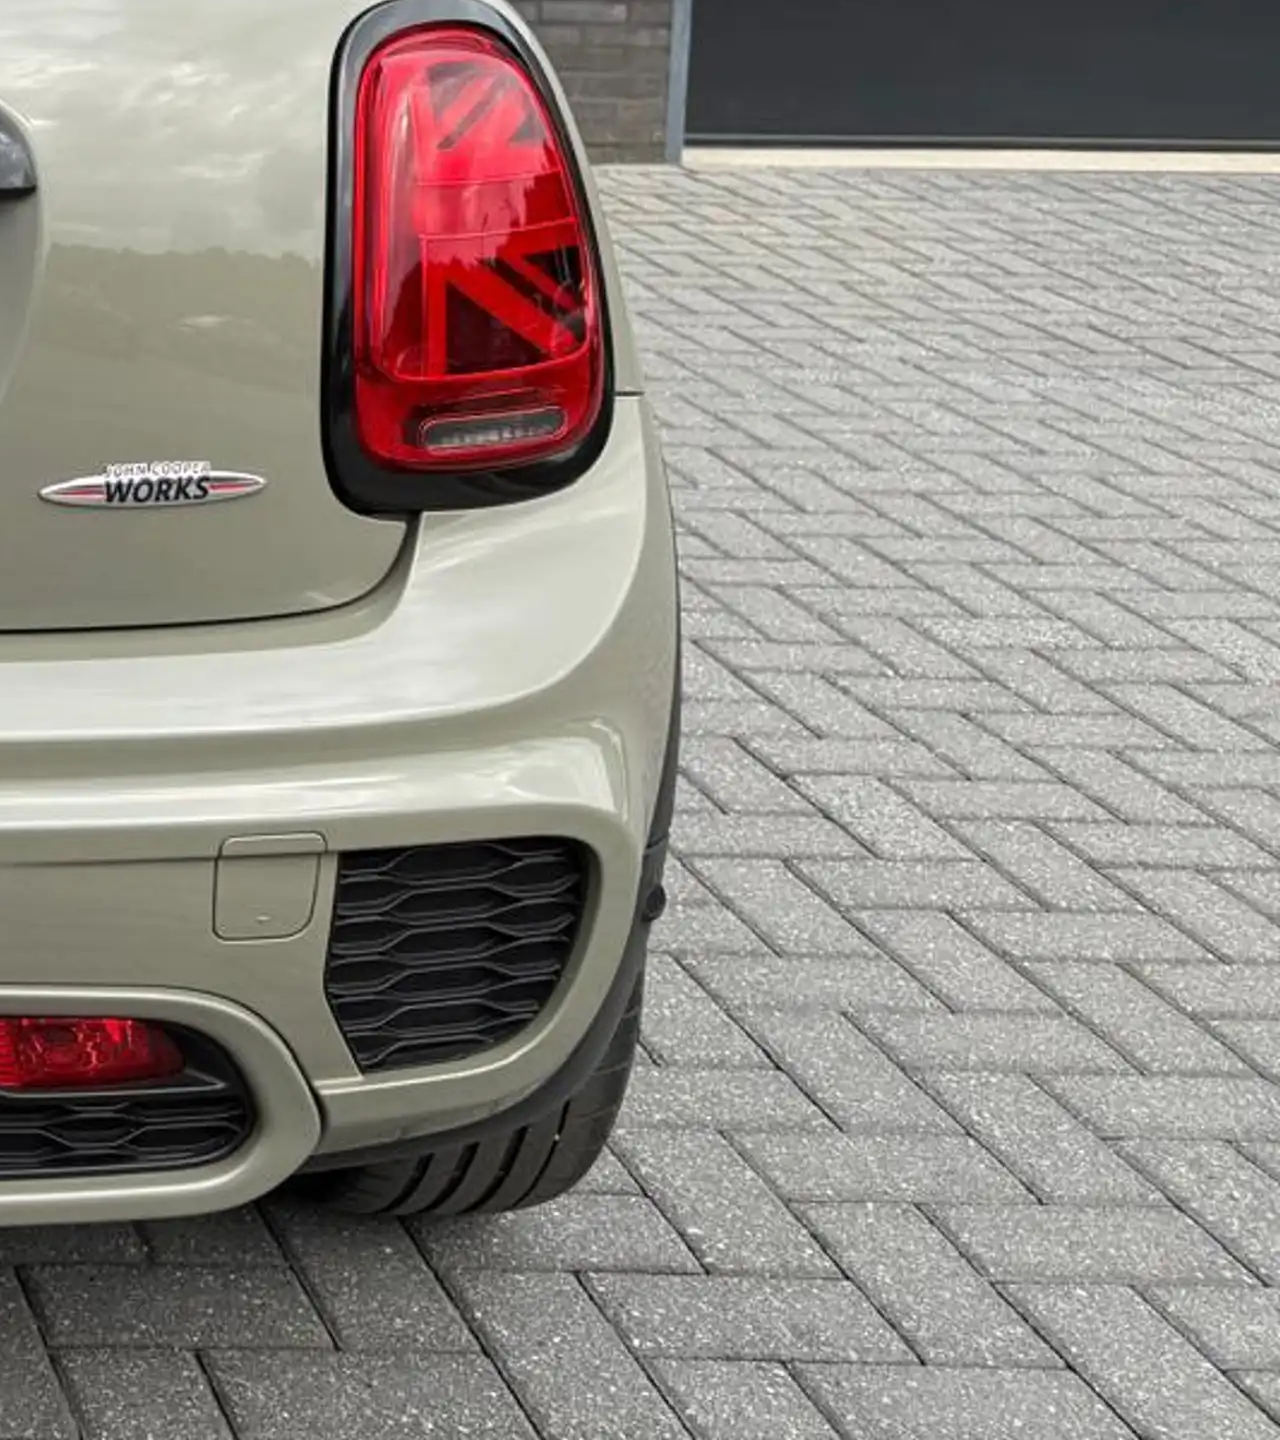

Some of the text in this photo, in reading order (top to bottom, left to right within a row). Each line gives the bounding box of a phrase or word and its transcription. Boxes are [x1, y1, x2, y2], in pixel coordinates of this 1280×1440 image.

[105, 461, 211, 478] JOHN COOPER
[104, 476, 211, 504] WORKS
